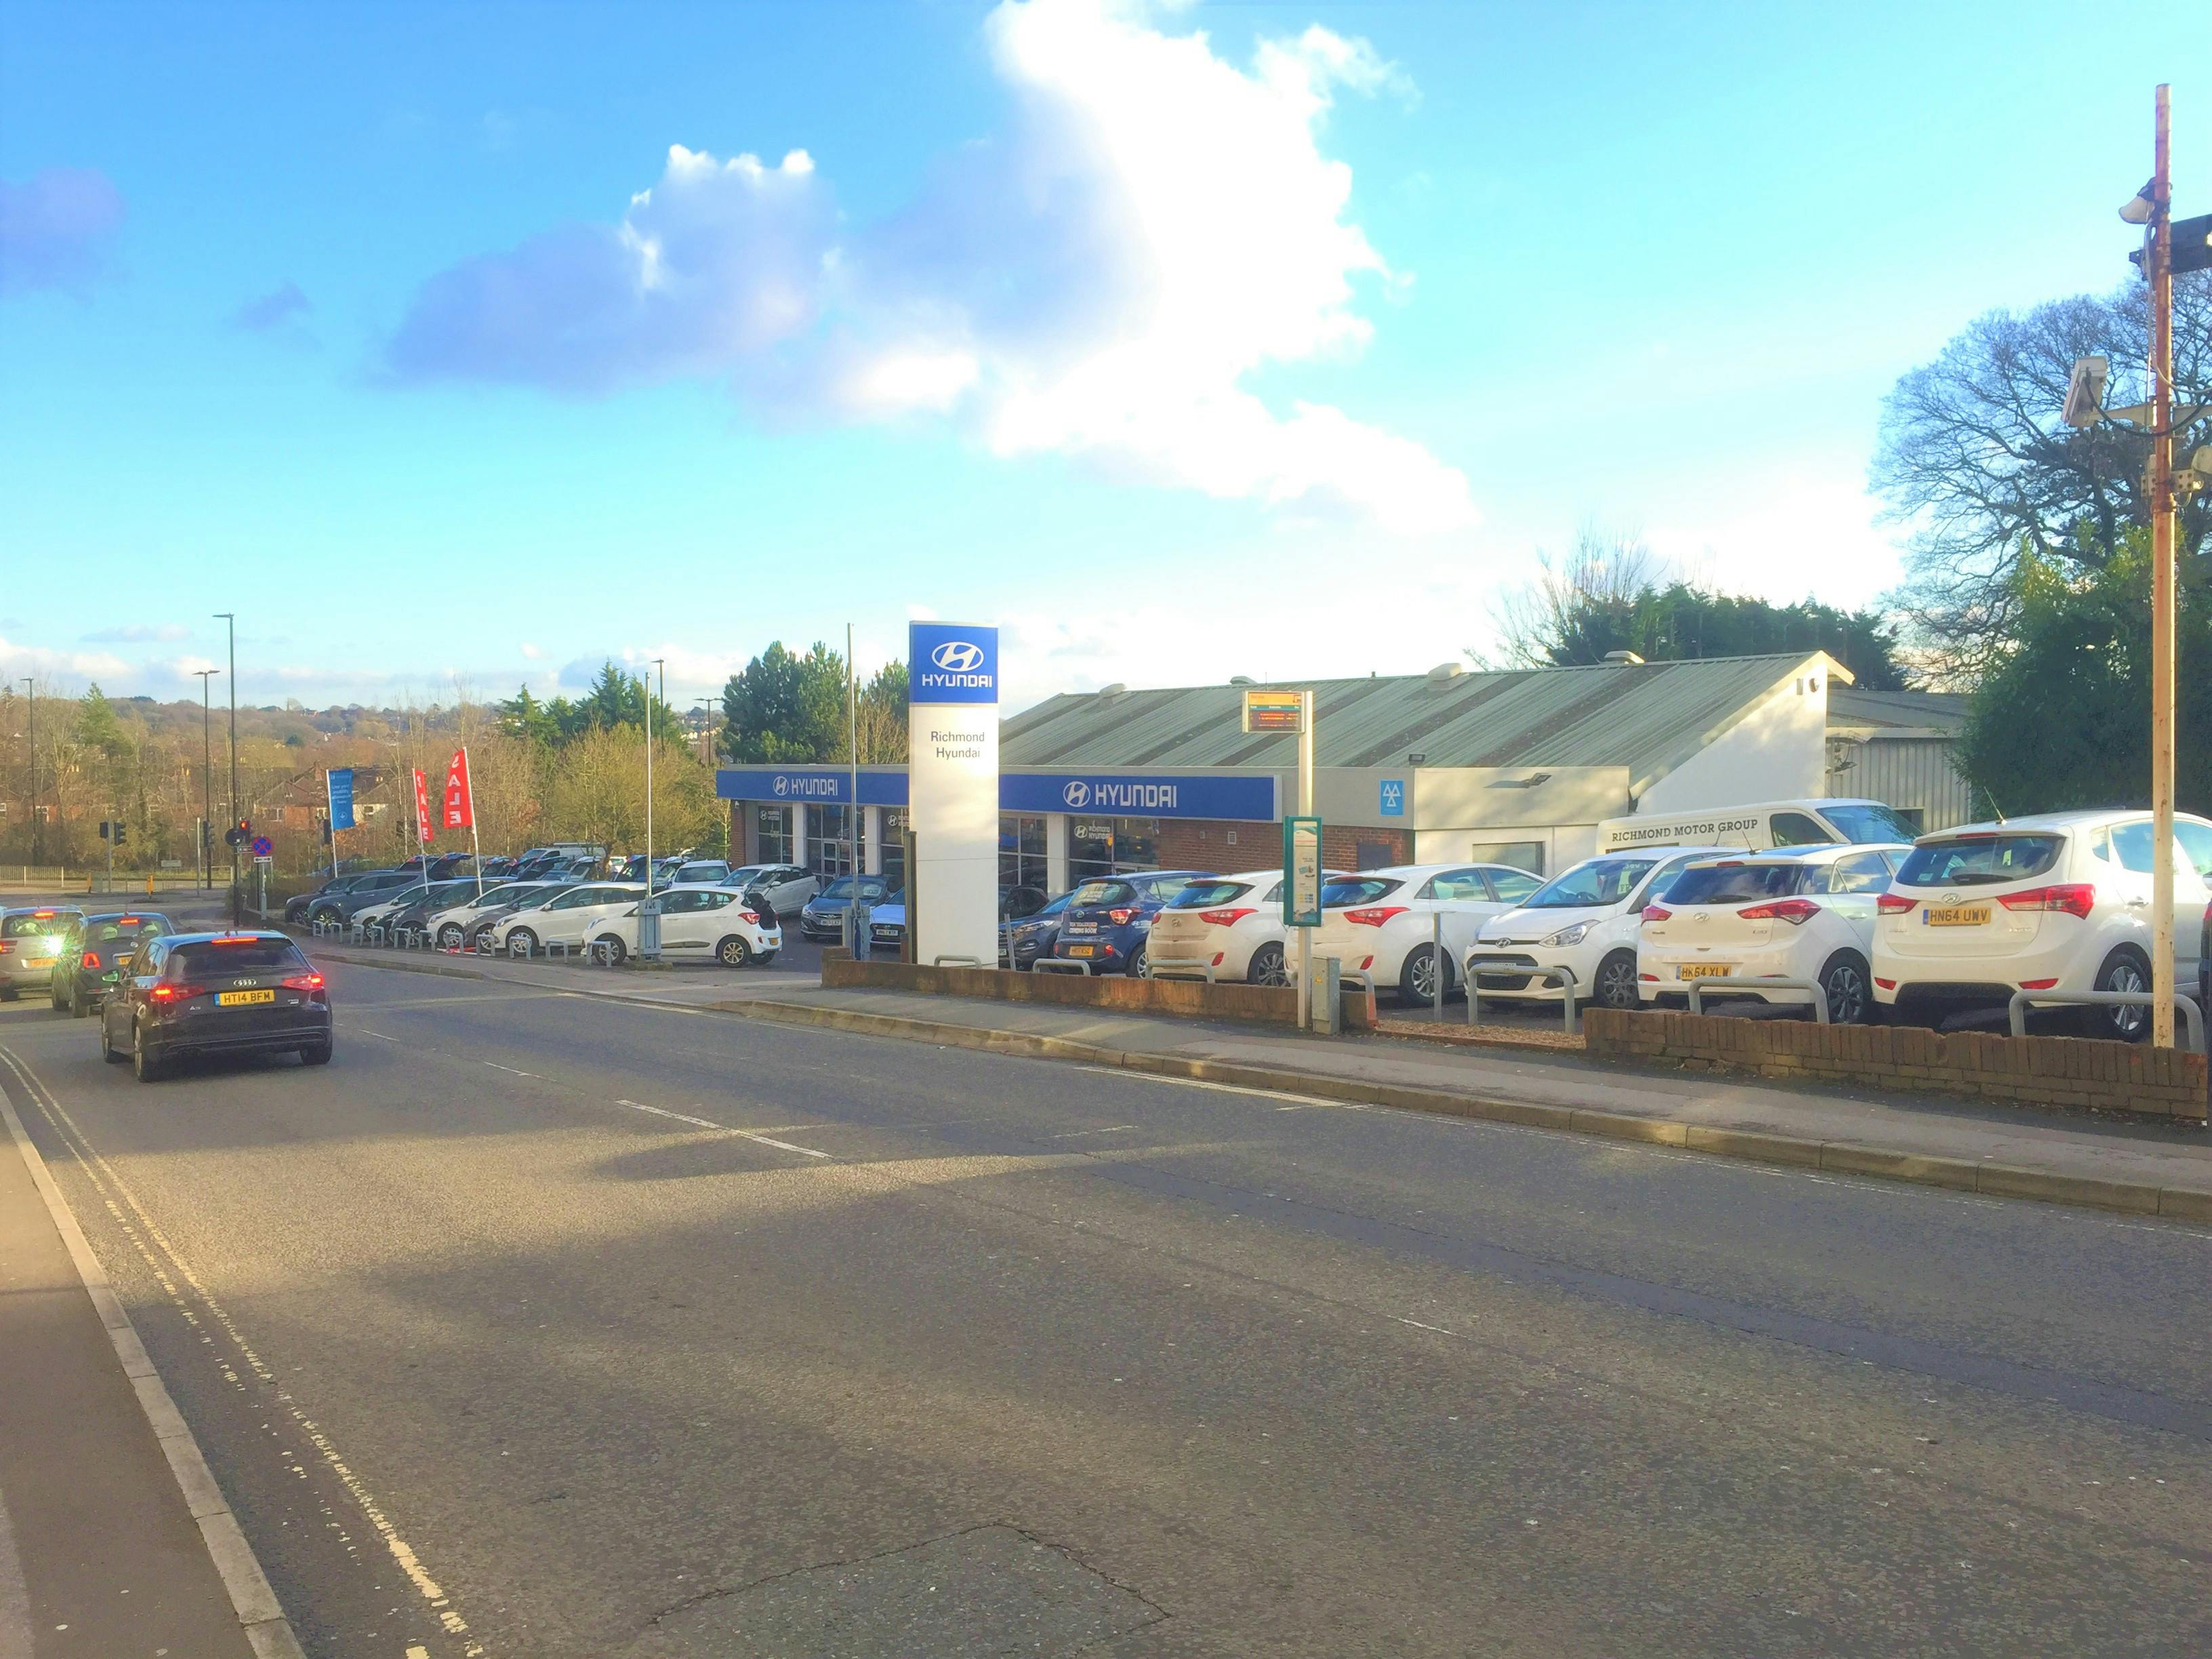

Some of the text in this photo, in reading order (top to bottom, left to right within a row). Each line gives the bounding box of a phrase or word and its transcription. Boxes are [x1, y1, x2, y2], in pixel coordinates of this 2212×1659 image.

[922, 674, 992, 688] HYUNDAI
[930, 731, 985, 742] Richmond
[936, 747, 980, 760] Hyundai
[791, 778, 838, 796] HYUNDAI
[1095, 784, 1177, 808] HYUNDAI
[417, 775, 429, 840] SALE
[1612, 819, 1758, 842] RICHMOND MOTOR GROUP
[1930, 909, 1988, 922] HN64 UWV
[1681, 967, 1706, 977] HK64
[224, 991, 270, 1003] HT14 BFM
